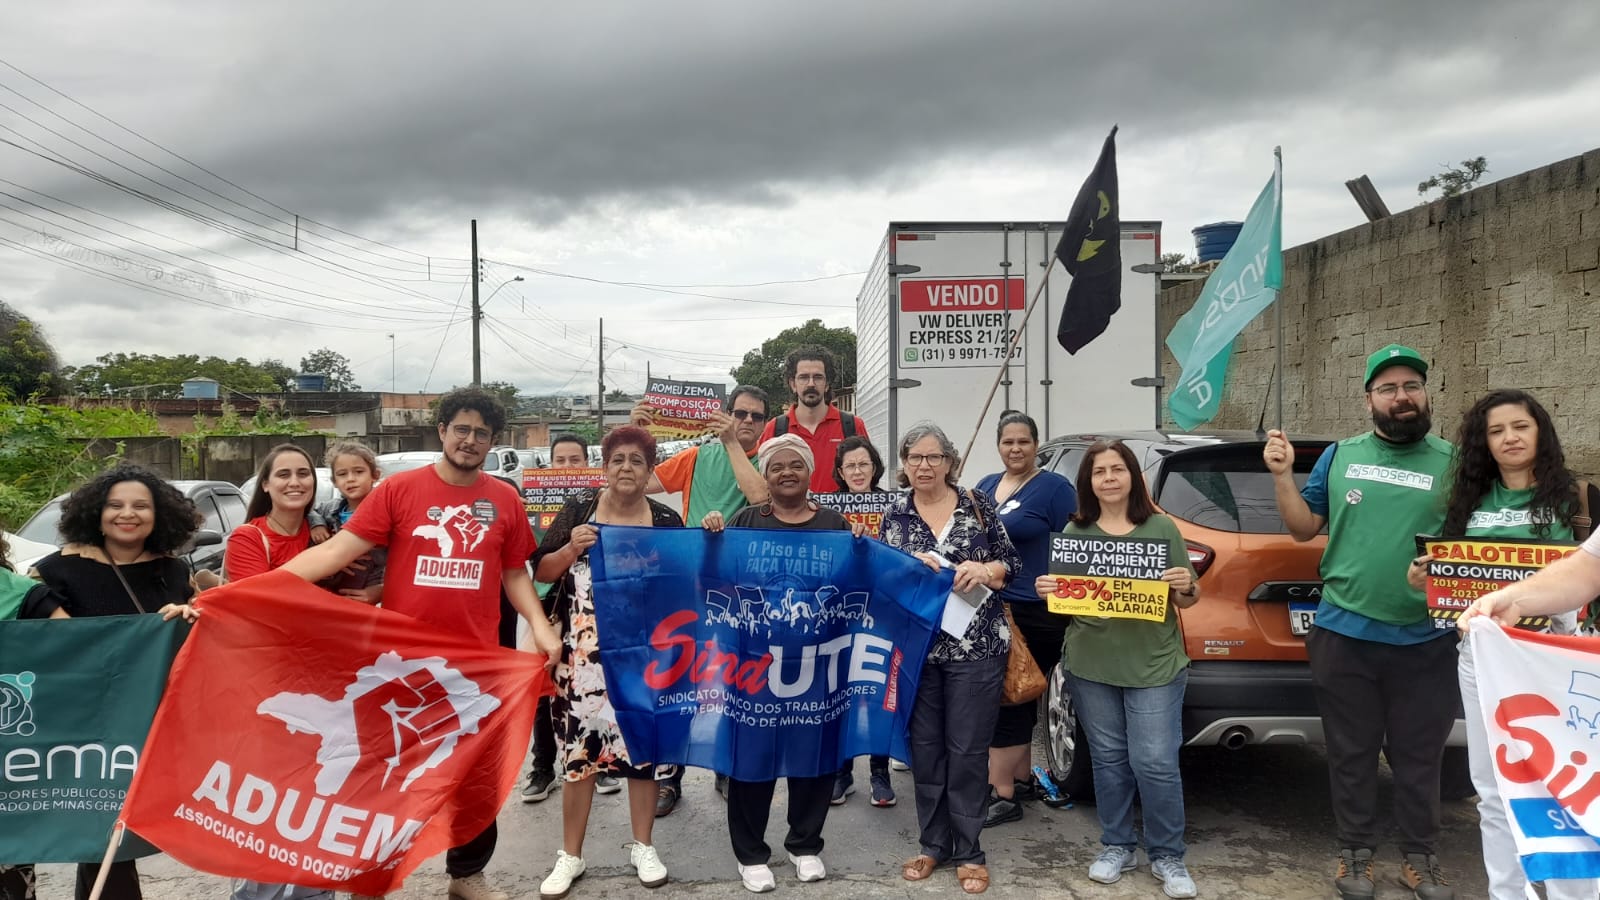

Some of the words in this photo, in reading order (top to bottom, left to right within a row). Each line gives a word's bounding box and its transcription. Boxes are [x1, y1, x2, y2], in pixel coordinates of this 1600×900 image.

[926, 284, 998, 306] VENDO
[919, 314, 941, 328] VW
[946, 313, 1011, 328] DELIVERY
[910, 331, 972, 344] EXPRESS
[922, 348, 944, 362] (31)
[949, 348, 955, 359] 9
[651, 383, 682, 395] ROMEU
[662, 408, 675, 416] DE
[813, 493, 886, 504] SERVIDORES
[748, 541, 757, 556] O
[762, 541, 793, 557] Piso
[812, 544, 832, 561] Lei
[1053, 538, 1144, 554] SERVIDORES
[1147, 543, 1167, 556] DE
[746, 557, 779, 577] FAÇA
[1051, 550, 1088, 564] MEIO
[1091, 554, 1166, 569] AMBIENTE
[419, 559, 480, 579] ADUEMG
[1087, 565, 1165, 579] ACUMULAM
[1431, 564, 1454, 576] NO
[1053, 578, 1113, 601] 85%
[1113, 580, 1132, 590] EM
[1433, 578, 1458, 587] 2019
[1471, 581, 1499, 590] 2020
[1113, 592, 1164, 605] PERDAS
[1452, 589, 1479, 598] 2023
[1098, 602, 1164, 617] SALARIAIS
[658, 689, 719, 706] SINDICATO
[755, 703, 781, 714] DOS
[785, 685, 877, 712] TRABALHADORES
[699, 703, 755, 726] EDUCAÇÃO
[760, 718, 777, 727] DE
[780, 715, 822, 726] MINAS
[33, 800, 50, 810] DE
[53, 800, 92, 810] MINAS
[173, 803, 265, 854] ASSOCIAÇÃO
[268, 844, 299, 867] DOS
